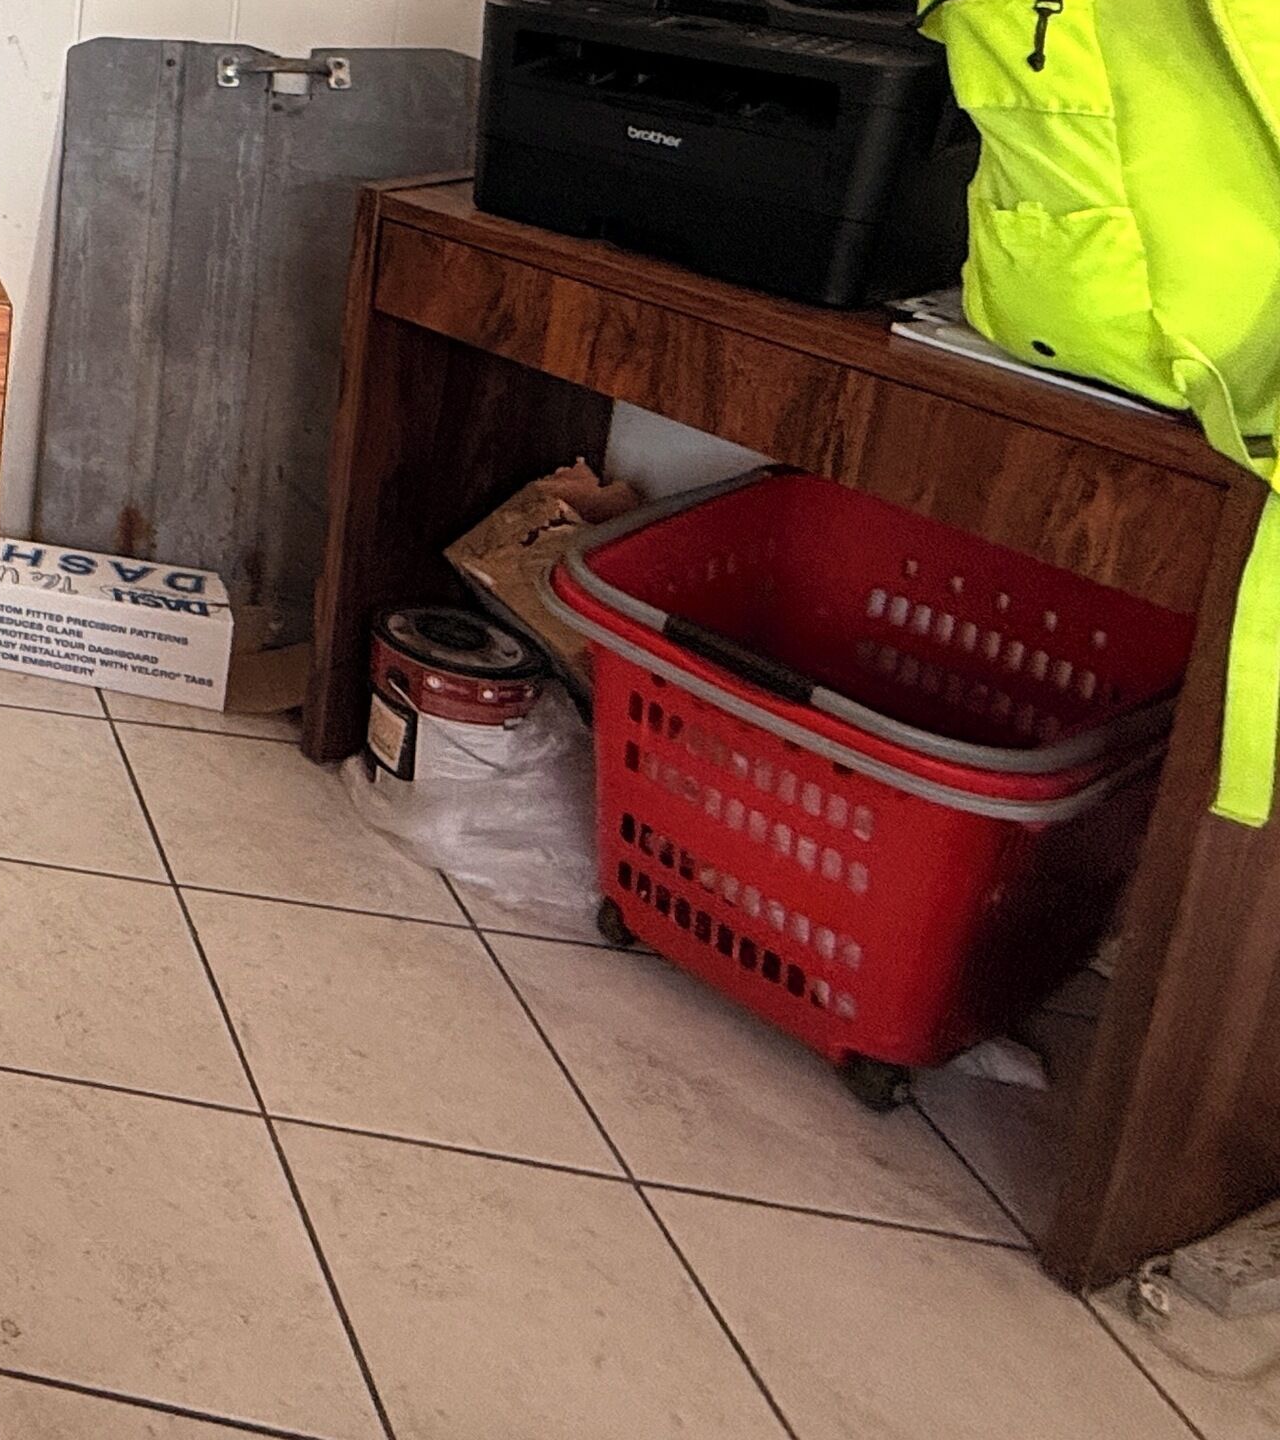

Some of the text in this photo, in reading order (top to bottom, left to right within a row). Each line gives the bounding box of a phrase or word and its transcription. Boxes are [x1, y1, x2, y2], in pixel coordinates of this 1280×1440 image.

[627, 125, 683, 149] brother
[2, 544, 206, 594] DASH
[26, 608, 64, 622] FITTED
[66, 616, 127, 635] PRECISION
[130, 628, 189, 646] PATTERNS
[46, 625, 83, 638] GLARE
[20, 643, 97, 665] INSTALLATION
[99, 658, 128, 671] WITH
[183, 674, 213, 687] TABS
[55, 638, 85, 651] YOUR
[88, 644, 159, 665] DASHBOARD
[22, 656, 94, 677] EMBROIDERY
